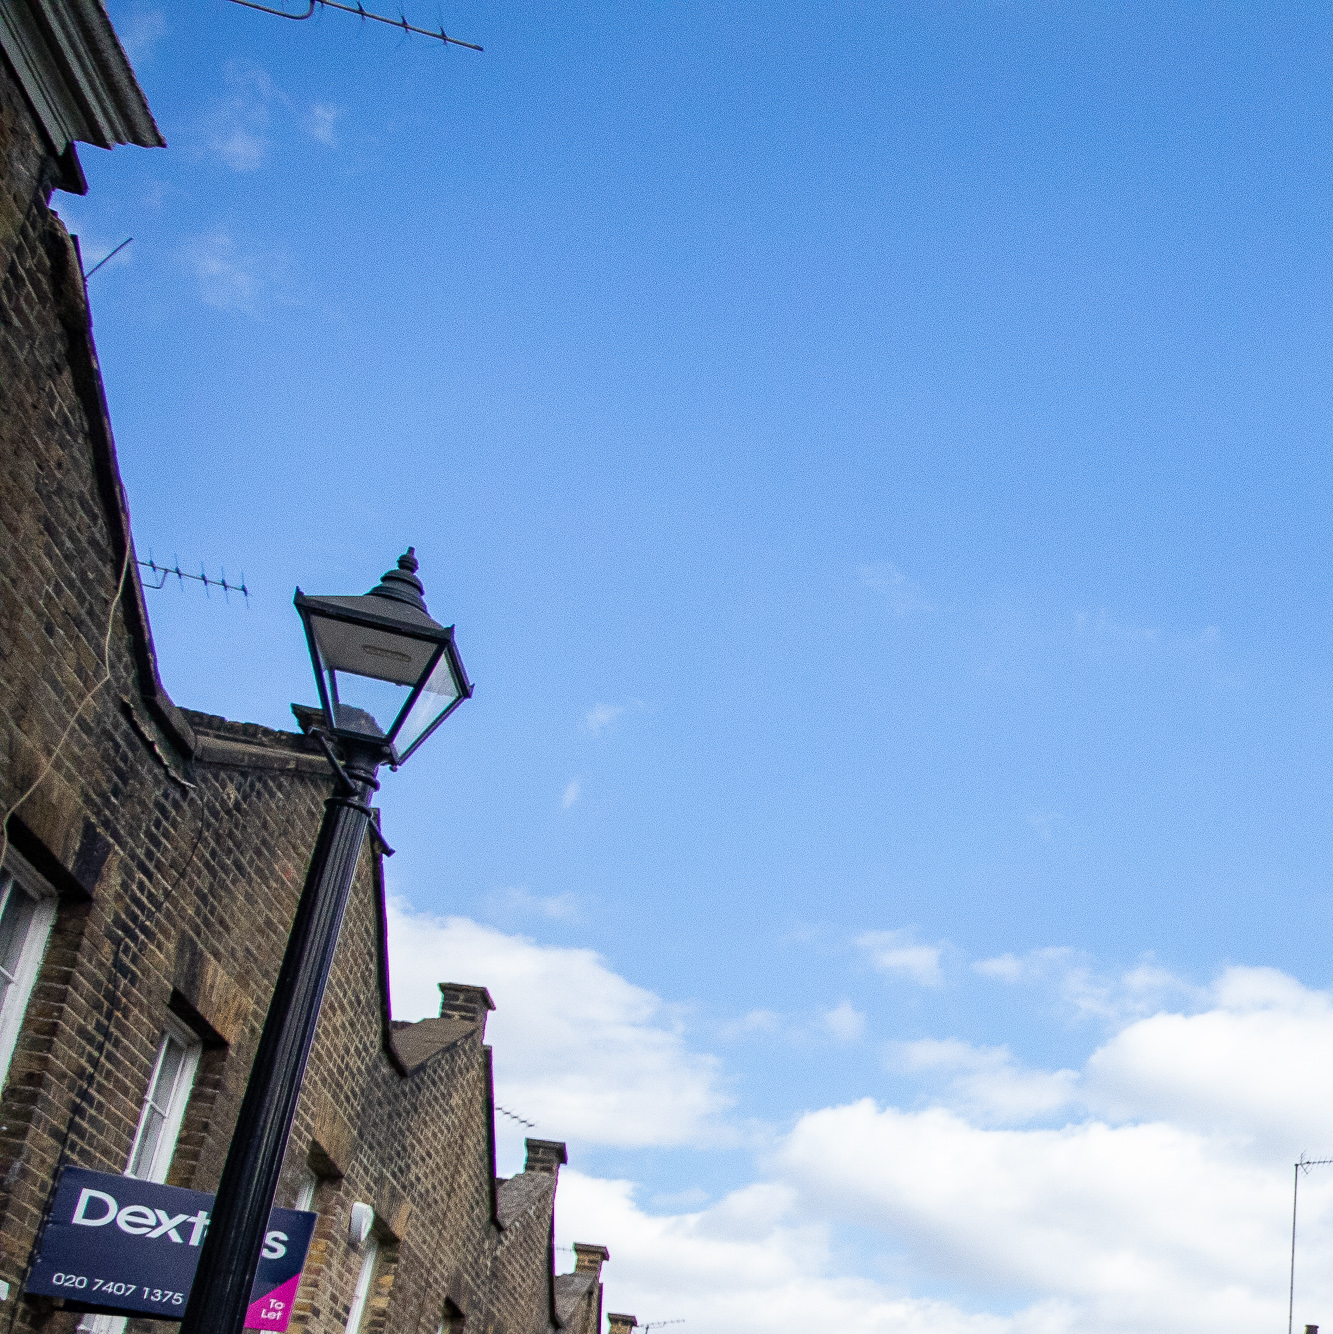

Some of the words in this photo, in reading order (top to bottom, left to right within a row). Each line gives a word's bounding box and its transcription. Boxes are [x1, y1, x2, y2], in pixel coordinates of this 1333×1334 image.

[72, 1187, 290, 1260] Dexts
[52, 1272, 87, 1290] 020
[93, 1277, 136, 1297] 7407
[142, 1286, 184, 1305] 1375
[260, 1308, 283, 1321] Let
[269, 1298, 285, 1310] To
